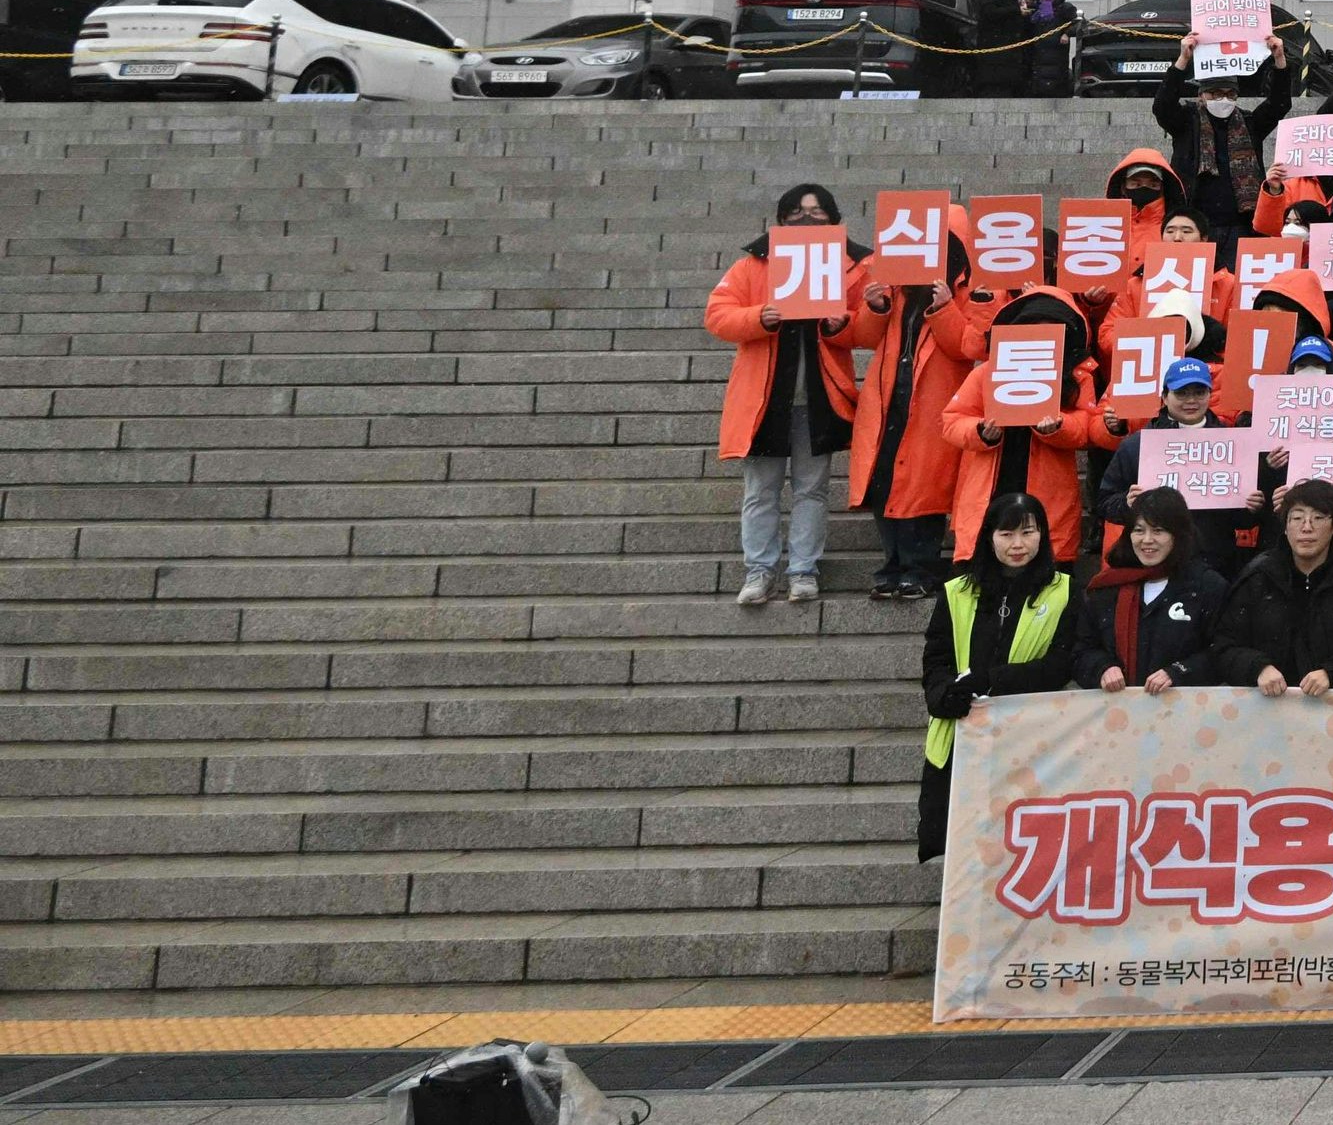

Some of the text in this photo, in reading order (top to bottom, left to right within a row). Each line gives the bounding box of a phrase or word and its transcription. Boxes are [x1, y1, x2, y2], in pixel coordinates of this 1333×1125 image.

[819, 9, 842, 18] 8294
[1206, 15, 1243, 28] 우리의
[1287, 149, 1303, 166] 개
[879, 208, 940, 267] 식
[975, 212, 1039, 272] 용
[1062, 216, 1124, 275] 종
[774, 242, 841, 301] 개
[992, 340, 1057, 406] 통
[1113, 334, 1184, 398] 과
[1268, 418, 1289, 439] 개
[1165, 441, 1234, 466] 굿바이
[1185, 471, 1240, 496] 식용!
[1002, 790, 1135, 925] 개
[1004, 961, 1096, 988] 공동주최
